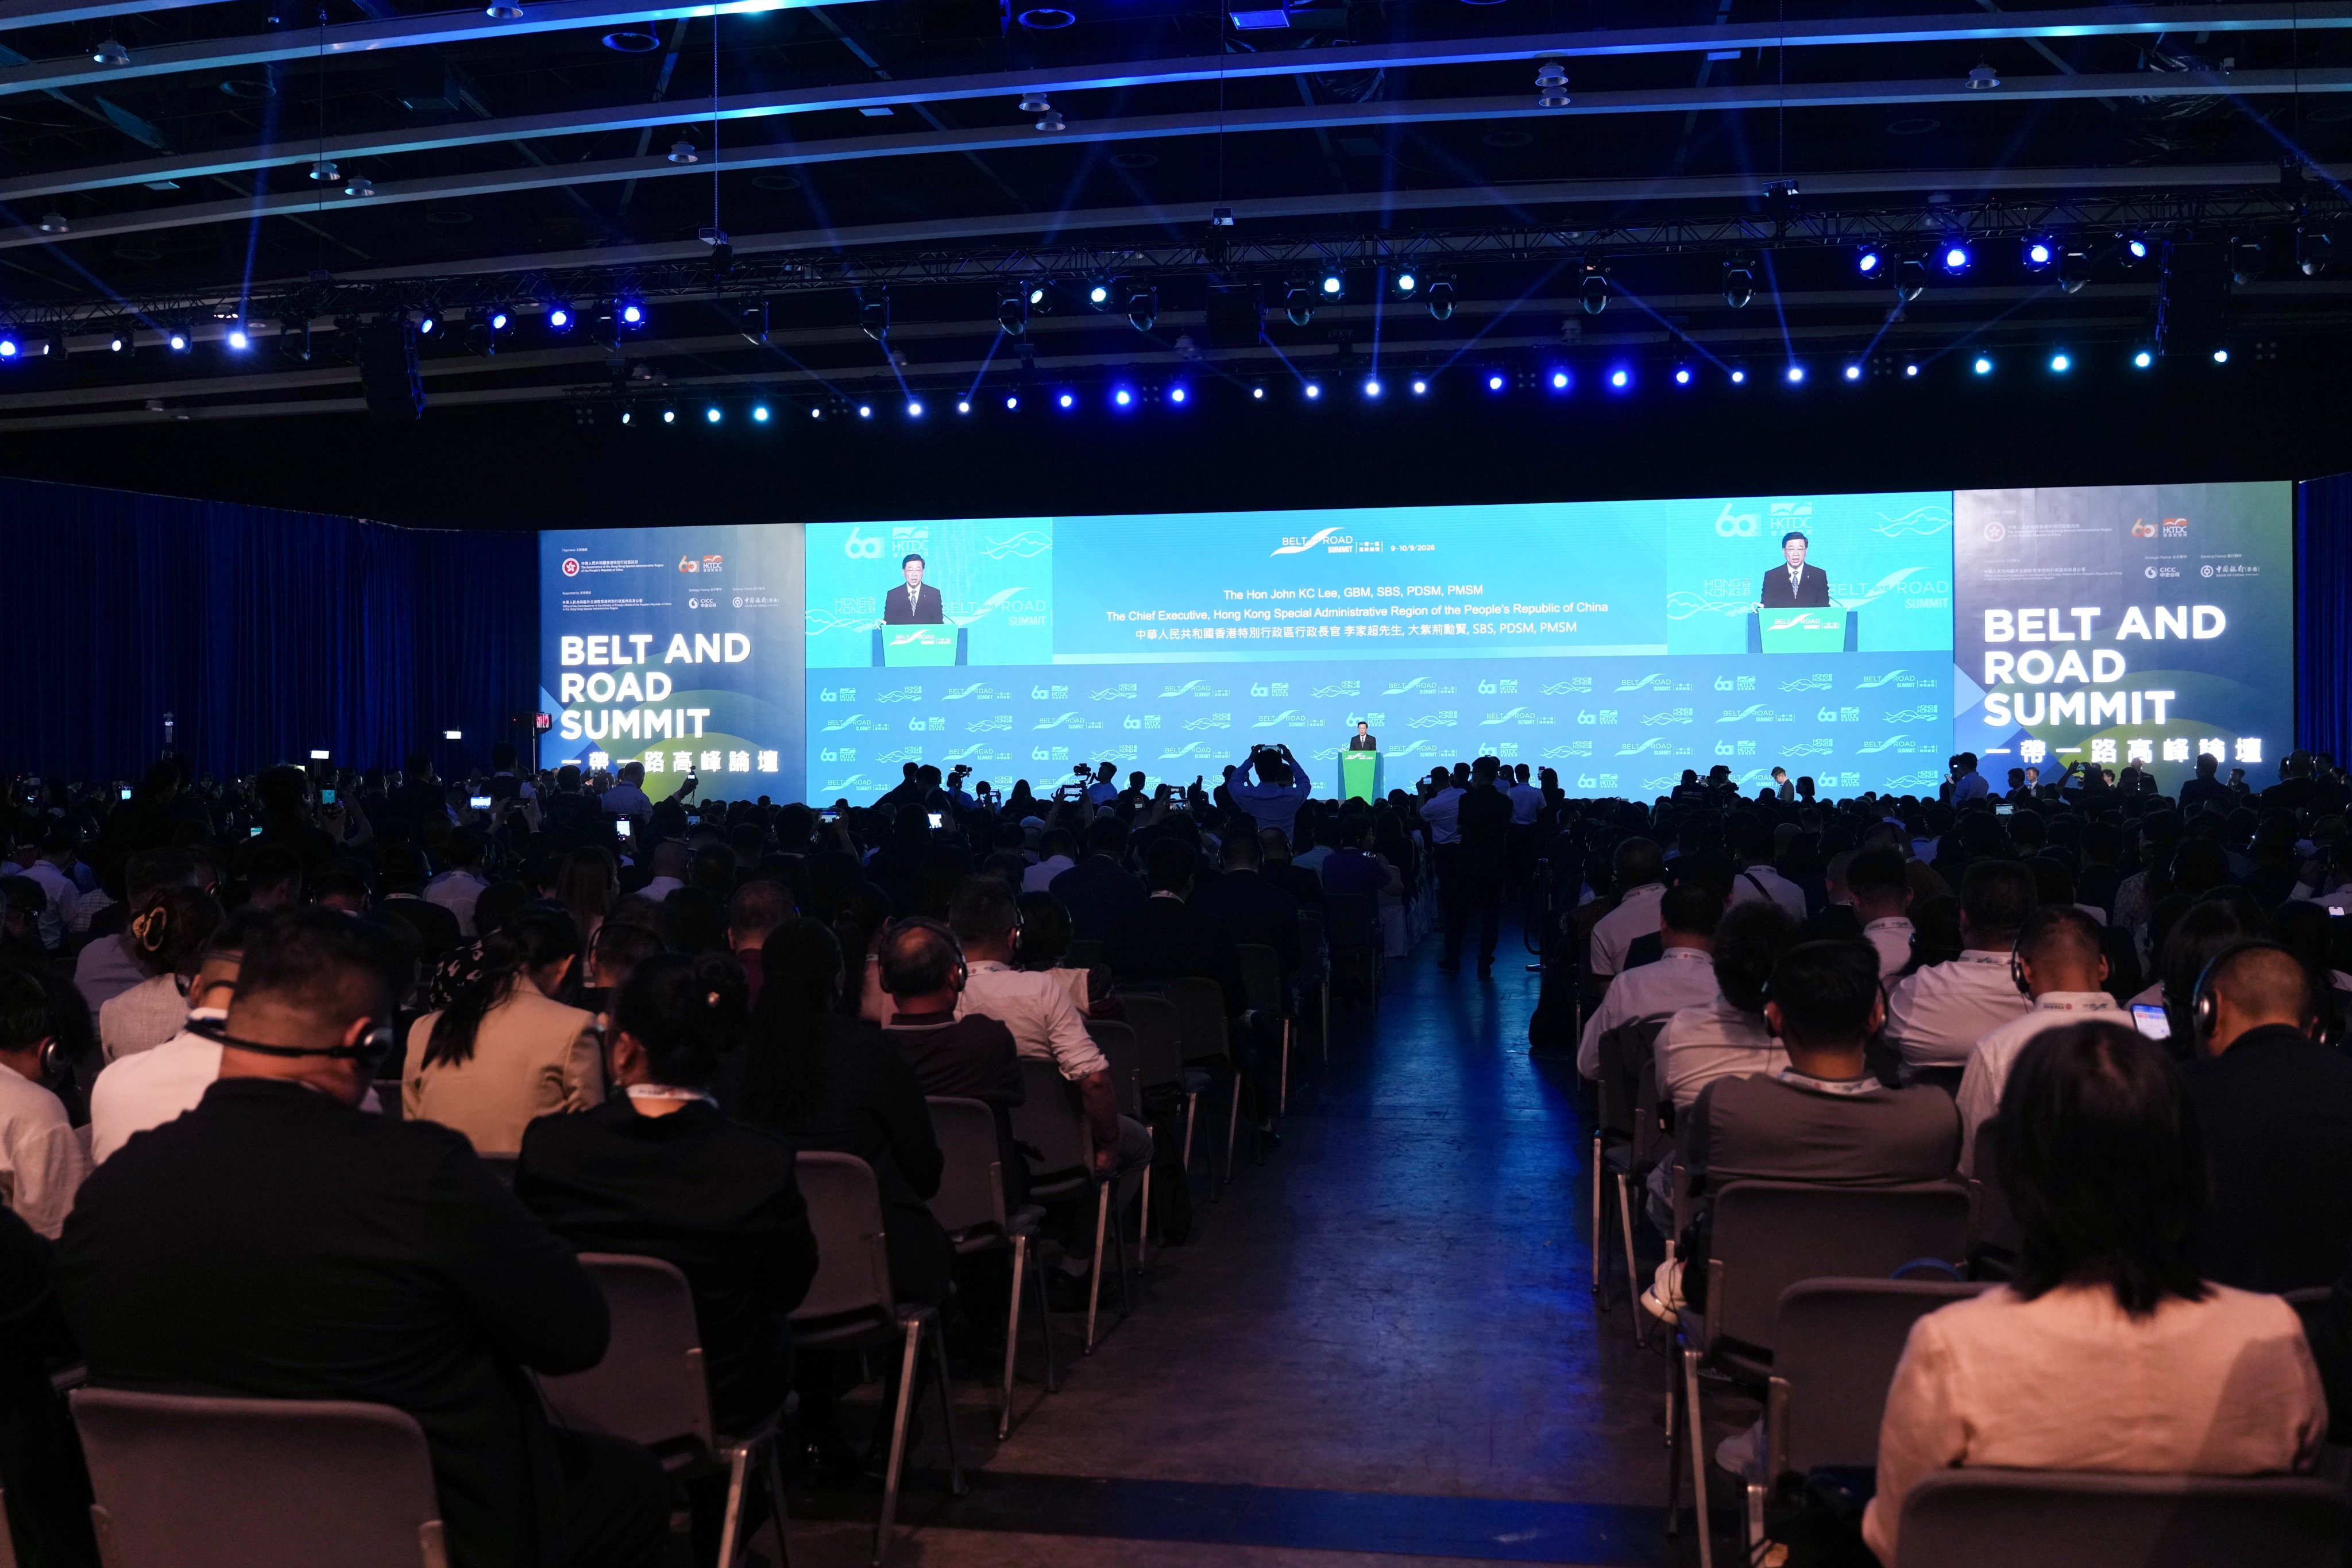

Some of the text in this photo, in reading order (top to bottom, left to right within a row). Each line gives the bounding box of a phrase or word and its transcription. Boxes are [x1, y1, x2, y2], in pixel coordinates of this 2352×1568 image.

[1771, 517, 1813, 528] HKTDC
[893, 540, 928, 551] HKTDC
[1282, 537, 1307, 546] BELT
[1323, 536, 1353, 544] ROAD
[1705, 579, 1741, 588] HONG
[1829, 582, 1867, 596] BELT
[1896, 581, 1949, 594] ROAD
[1223, 585, 1483, 600] The Hon John KC Lee, GBM, SBS, PDSM, PMSM
[1705, 588, 1741, 597] KONG
[835, 597, 866, 606] HONG
[942, 602, 976, 613] BELT
[1002, 600, 1046, 612] ROAD
[1905, 597, 1948, 609] SUMMIT
[1106, 602, 1608, 621] The Chief Executive, Hong Kong Special Administrative Region of the People’s Republic of China
[1009, 616, 1046, 626] SUMMIT
[1984, 605, 2225, 642] BELT AND
[1136, 625, 1341, 640] 中華人民共和國香港特別行政區行政長官
[1344, 625, 1404, 637] 李家超先生,
[1473, 623, 1496, 635] SBS,
[1500, 623, 1536, 634] PDSM,
[1540, 621, 1577, 632] PMSM
[561, 633, 751, 666] BELT AND
[1984, 650, 2125, 685] ROAD
[561, 672, 671, 702] ROAD
[1983, 691, 2175, 726] SUMMIT
[561, 709, 710, 740] SUMMIT
[1985, 737, 2262, 764] 一帶一路高峰論壇
[562, 750, 778, 773] 一帶一路高峰論壇
